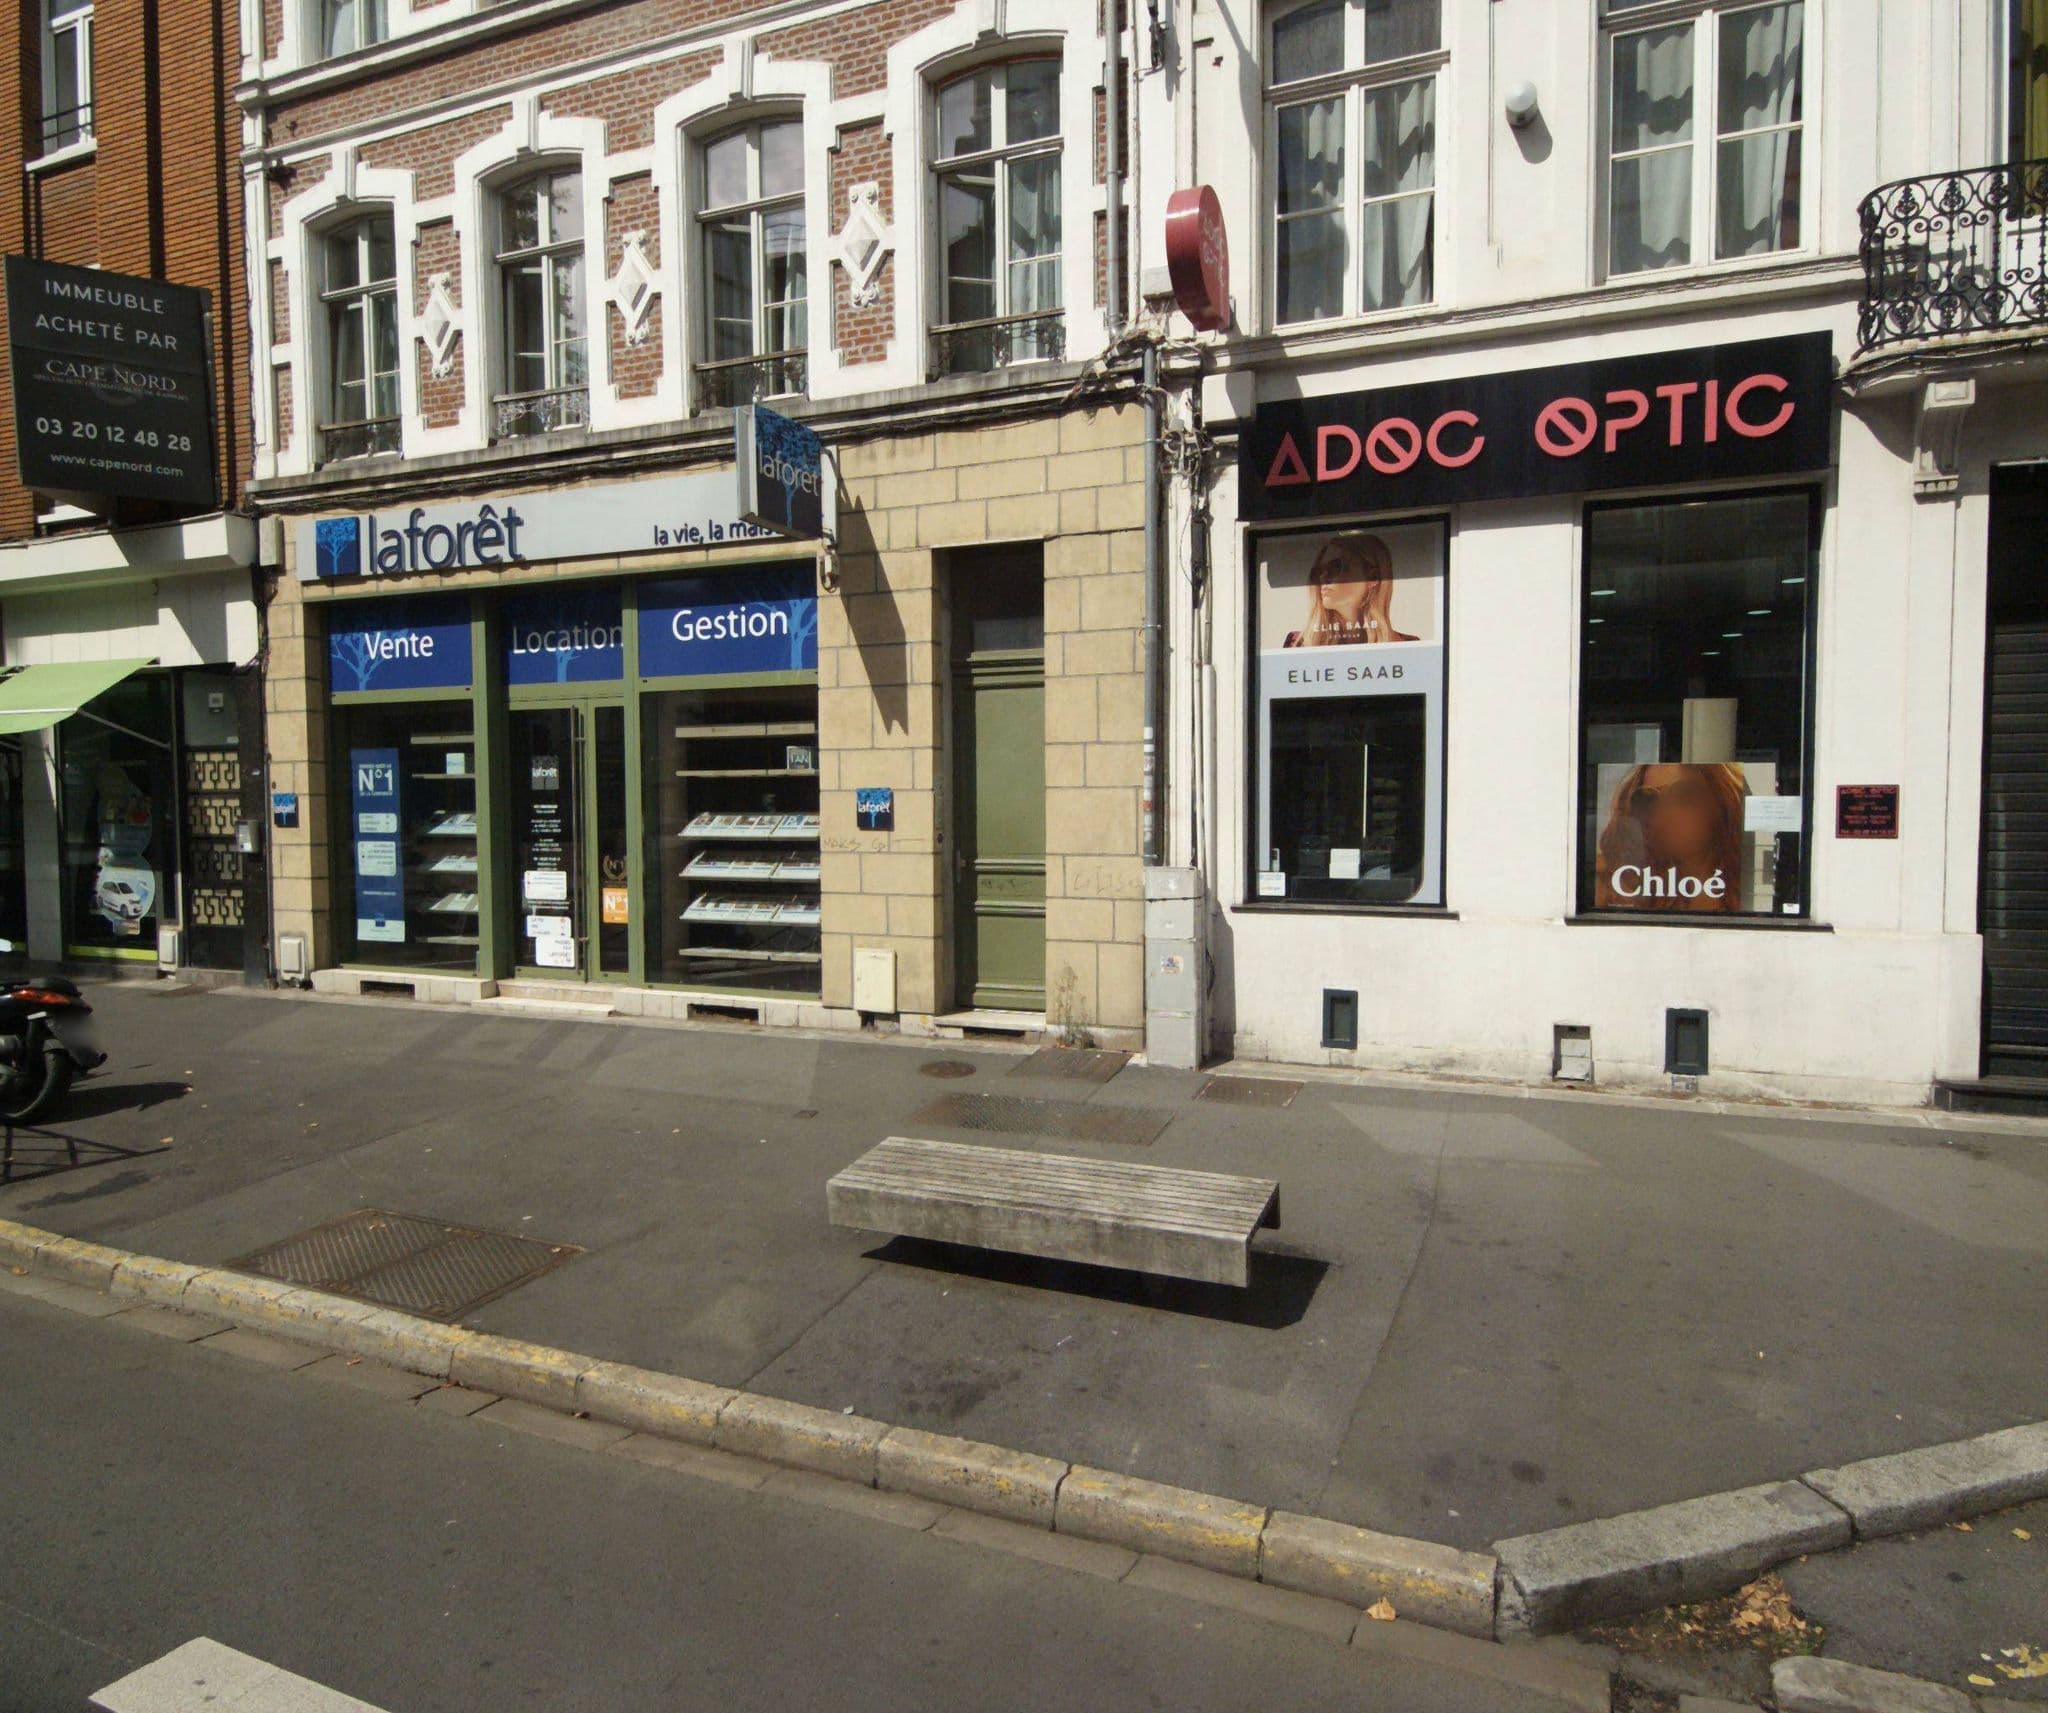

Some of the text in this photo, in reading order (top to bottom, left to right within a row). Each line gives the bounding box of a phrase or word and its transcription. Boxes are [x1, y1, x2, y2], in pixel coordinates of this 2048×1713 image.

[45, 279, 165, 314] IMMEUBLE
[35, 313, 177, 350] ACHETÉ PAR
[46, 359, 105, 380] CAPE
[112, 364, 176, 392] NORD
[36, 416, 191, 451] 03 20 12 48 28
[51, 452, 184, 477] www.capenord.com
[759, 443, 819, 496] laforêt
[369, 504, 526, 574] laforêt
[654, 525, 669, 546] la
[673, 523, 704, 544] vie,
[708, 519, 724, 541] la
[513, 622, 624, 654] Location
[672, 607, 788, 641] Gestion
[364, 632, 434, 660] Vente
[1288, 665, 1404, 683] ELIE SAAB
[358, 769, 393, 791] N°1
[1611, 865, 1726, 898] Chloé
